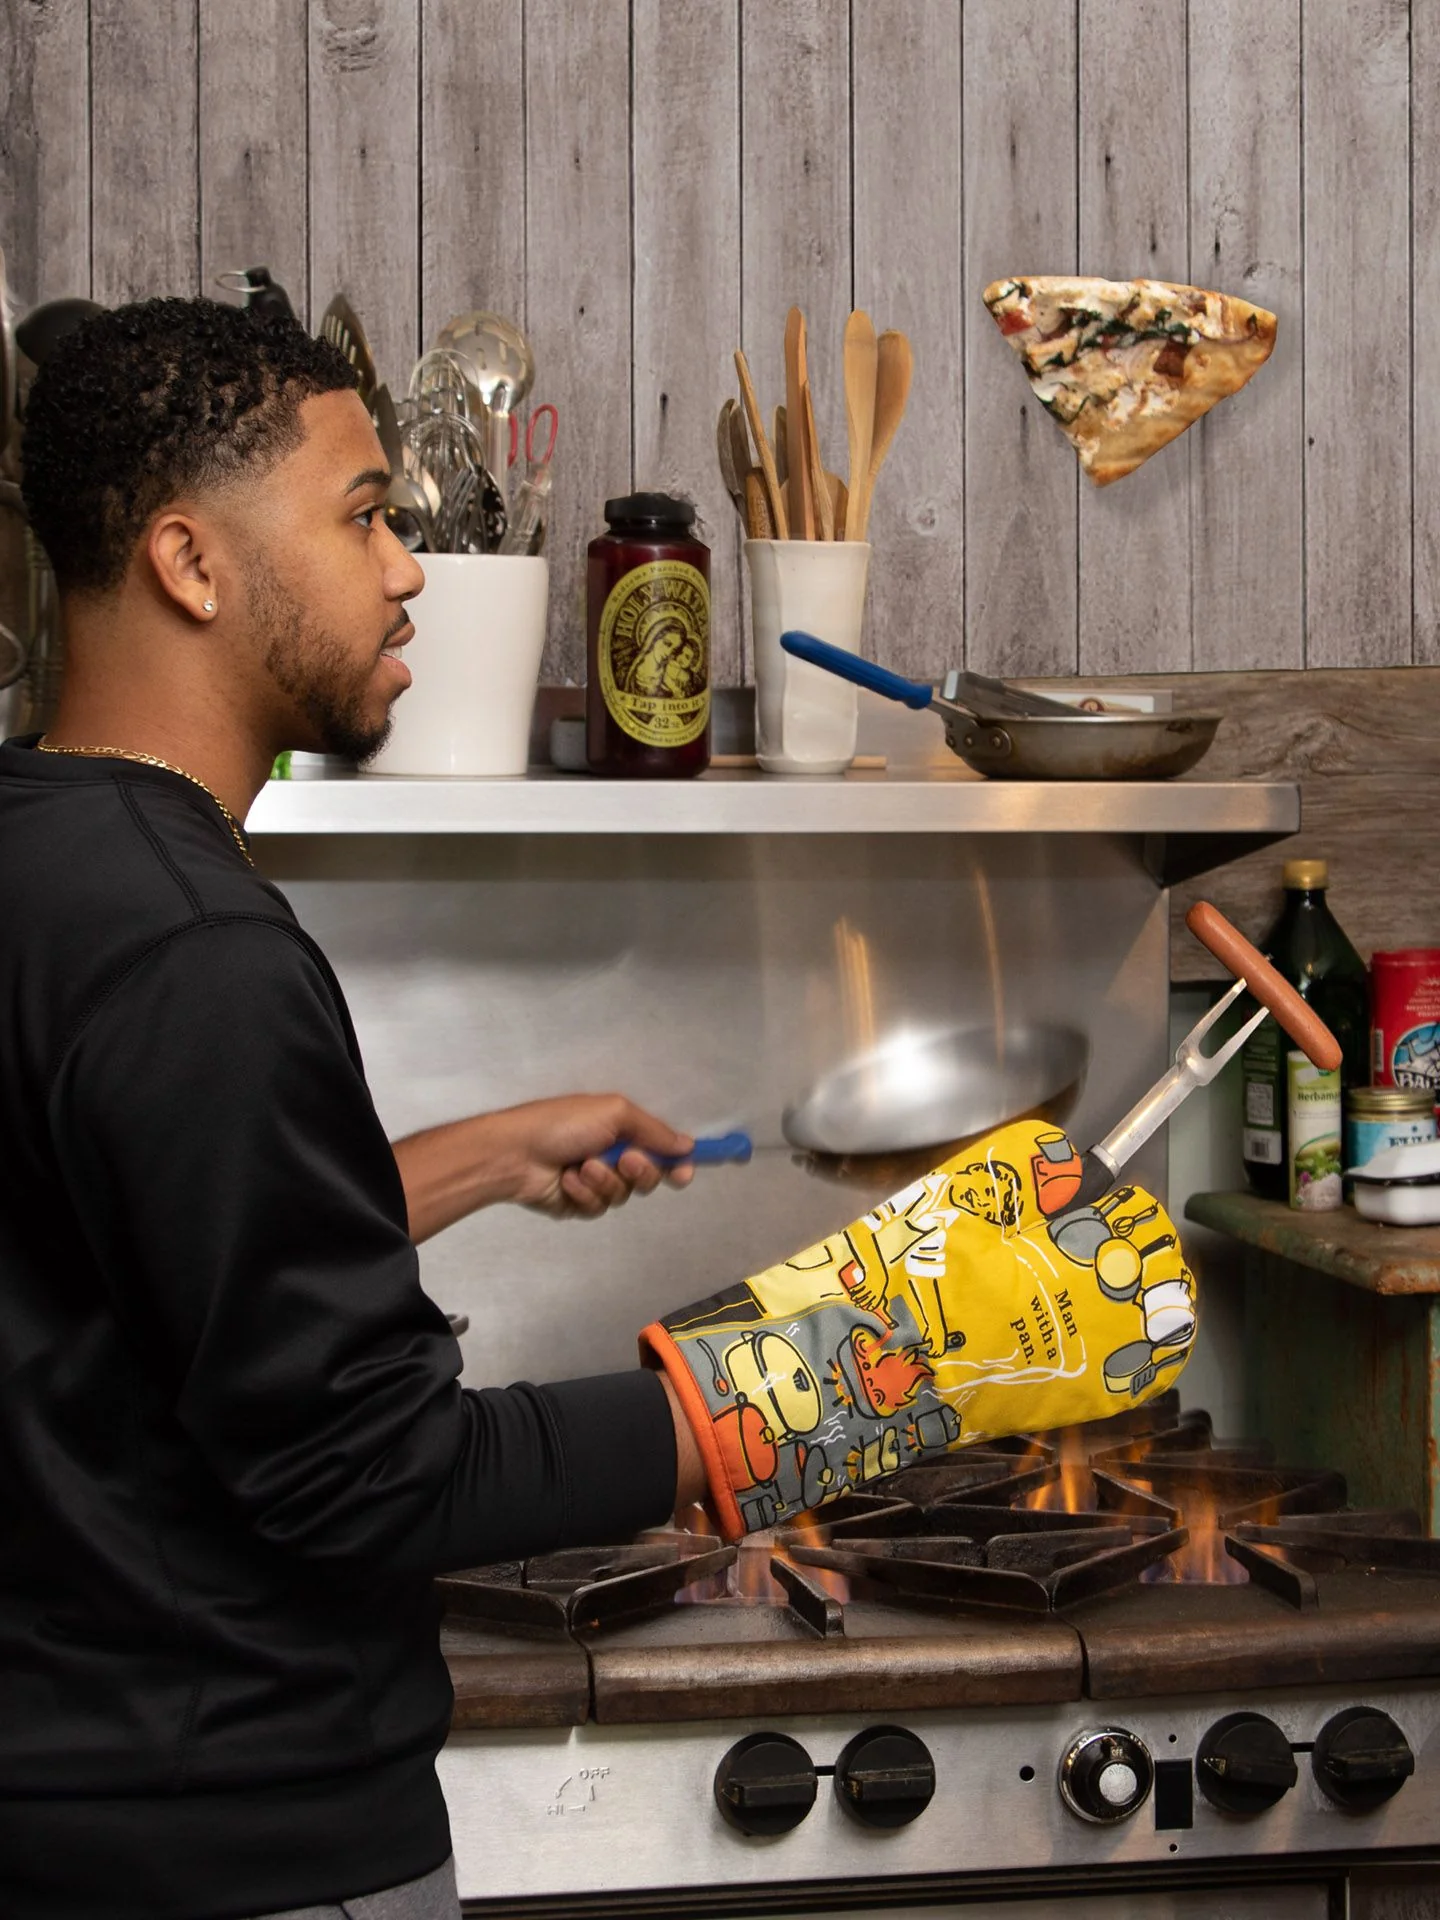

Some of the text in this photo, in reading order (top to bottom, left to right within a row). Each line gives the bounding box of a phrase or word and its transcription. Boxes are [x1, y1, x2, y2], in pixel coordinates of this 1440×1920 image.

[614, 580, 655, 639] HOLY
[632, 699, 657, 711] Tap
[662, 702, 689, 711] into
[654, 716, 670, 729] 32
[1030, 1295, 1057, 1360] with a
[1054, 1288, 1077, 1338] Man
[1010, 1316, 1035, 1365] pan.
[579, 1767, 610, 1780] OFF
